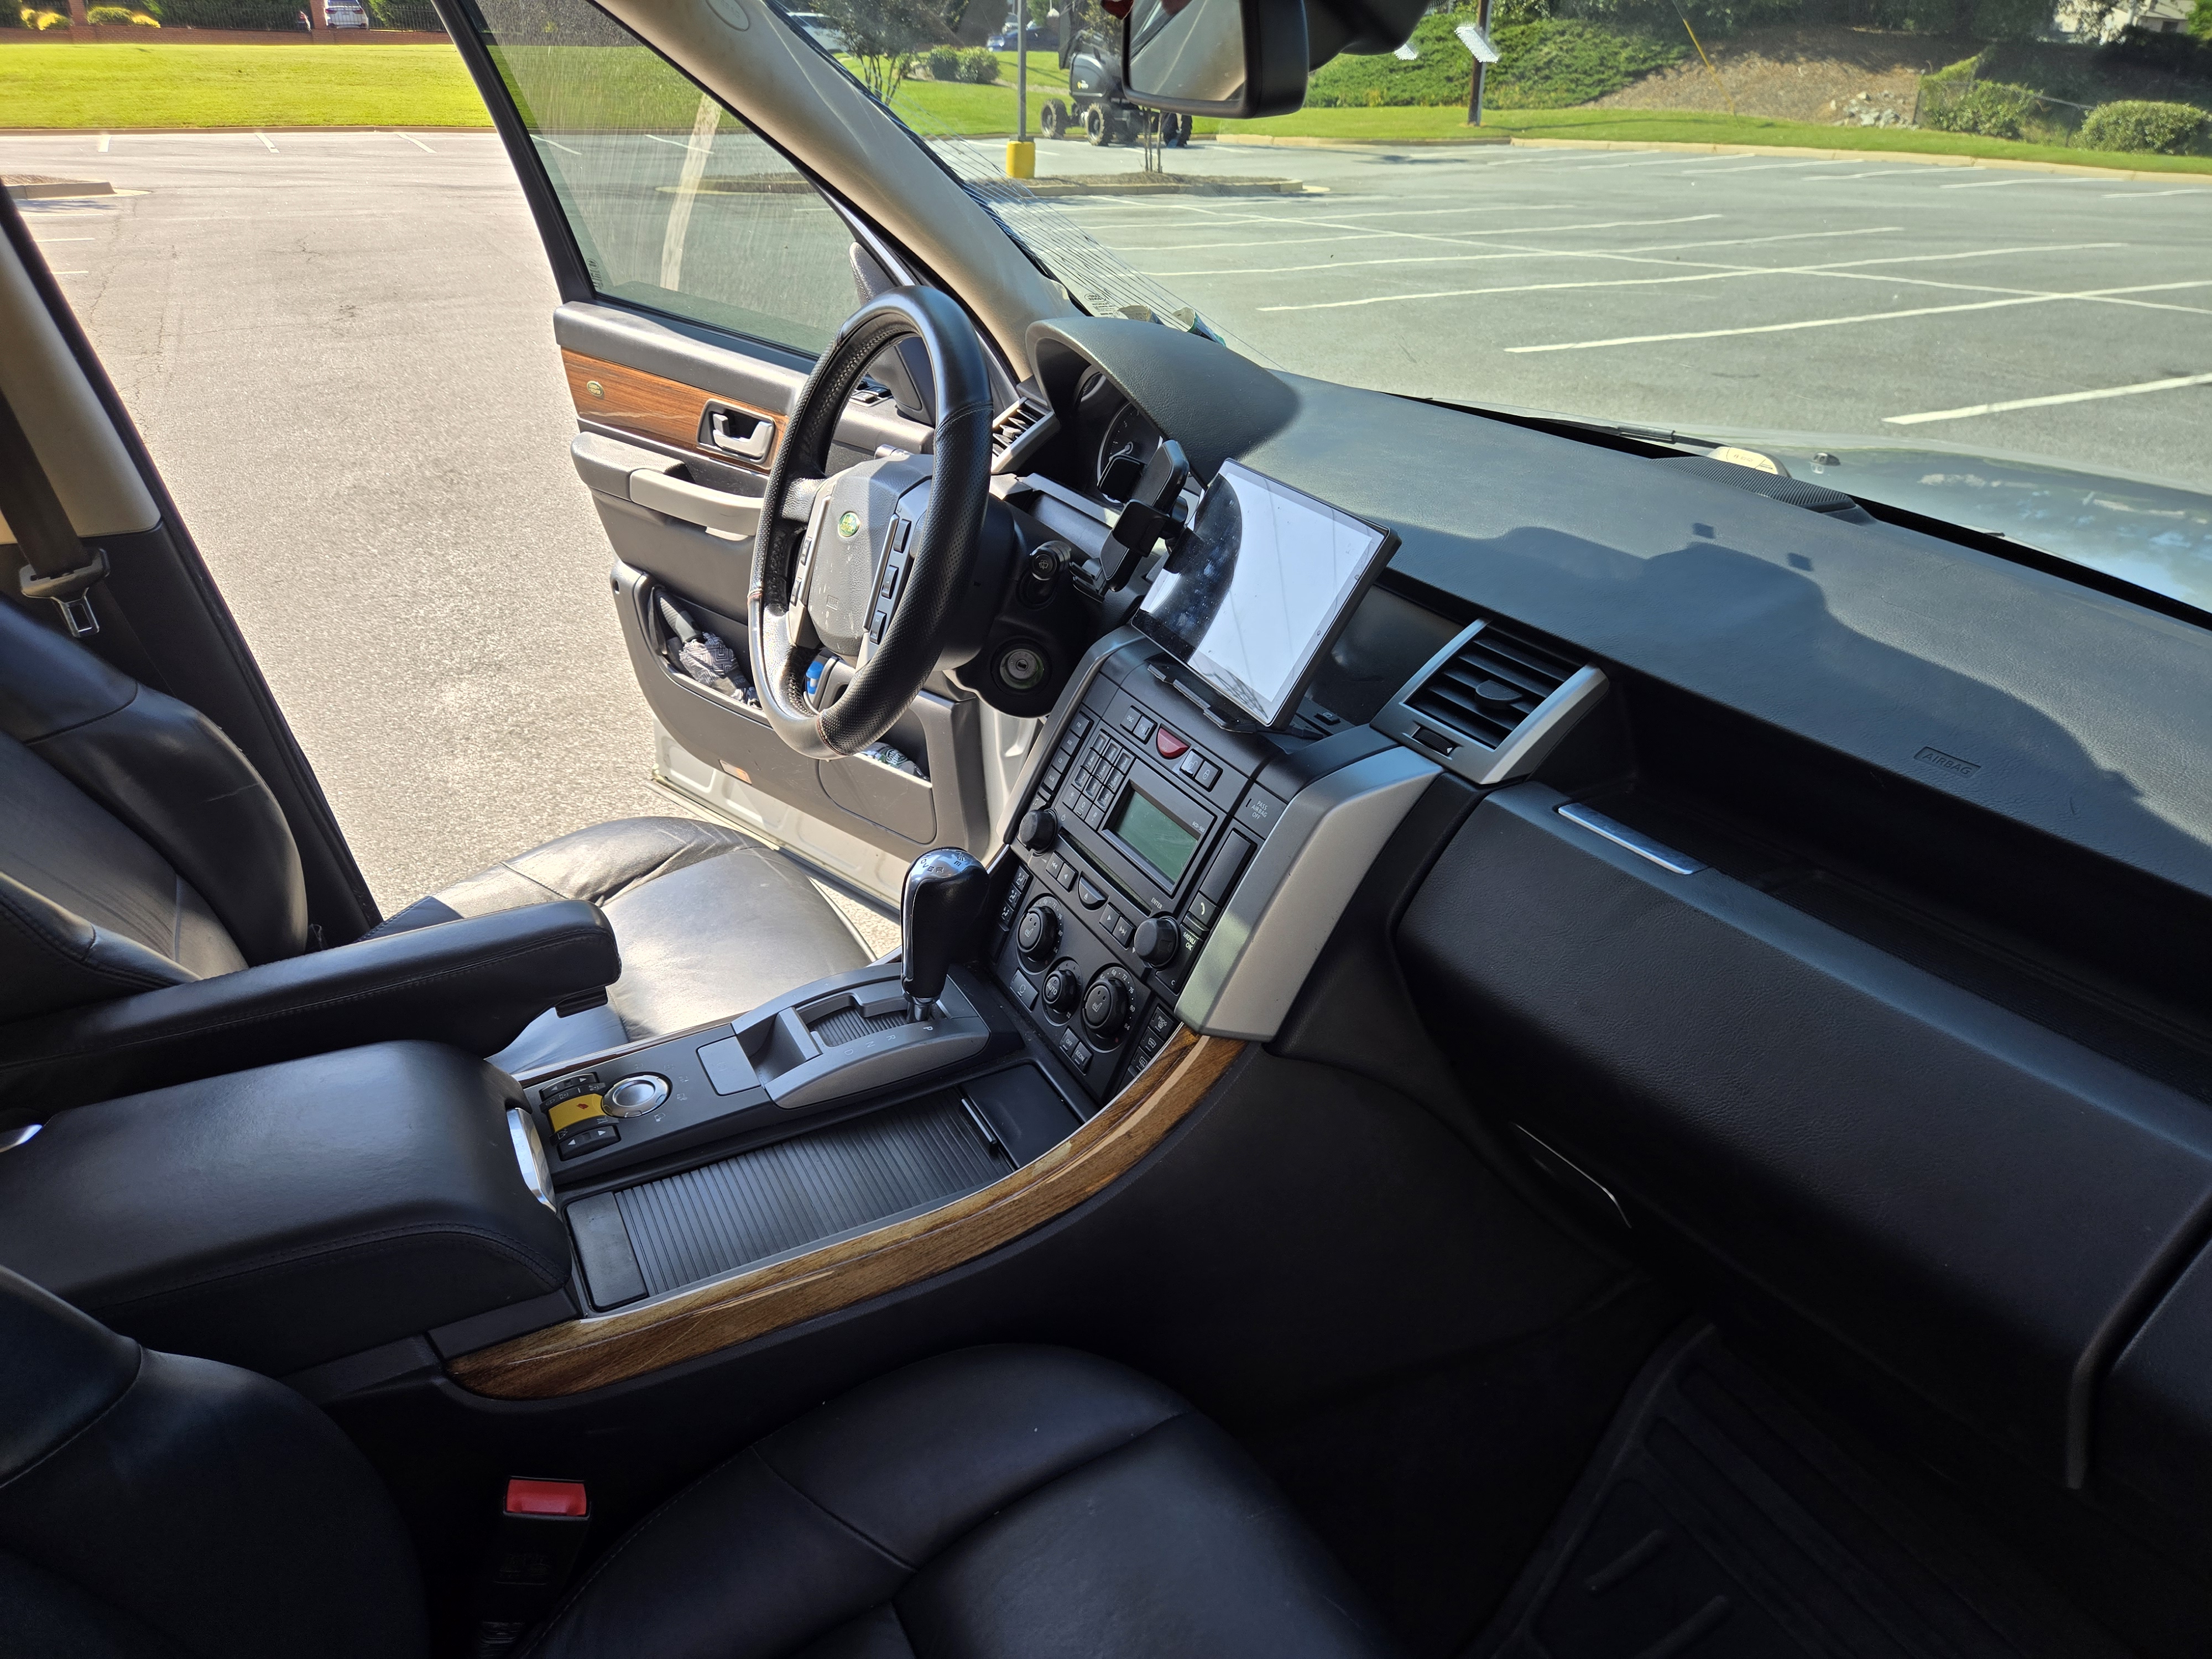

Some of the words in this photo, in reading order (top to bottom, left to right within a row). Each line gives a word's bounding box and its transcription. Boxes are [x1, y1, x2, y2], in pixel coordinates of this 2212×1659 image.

[1922, 753, 1973, 775] AIRBAG
[1251, 804, 1268, 818] AIRBAG
[1256, 800, 1269, 811] PASS
[1251, 811, 1261, 820] OFF
[1150, 897, 1163, 910] ENTER
[1183, 931, 1196, 946] MENU
[1185, 942, 1193, 951] OK
[1046, 981, 1058, 995] AUTO
[1129, 1004, 1135, 1013] 80
[1157, 1015, 1168, 1026] PROG
[1065, 1038, 1073, 1047] OFF
[1074, 1049, 1085, 1062] ECON
